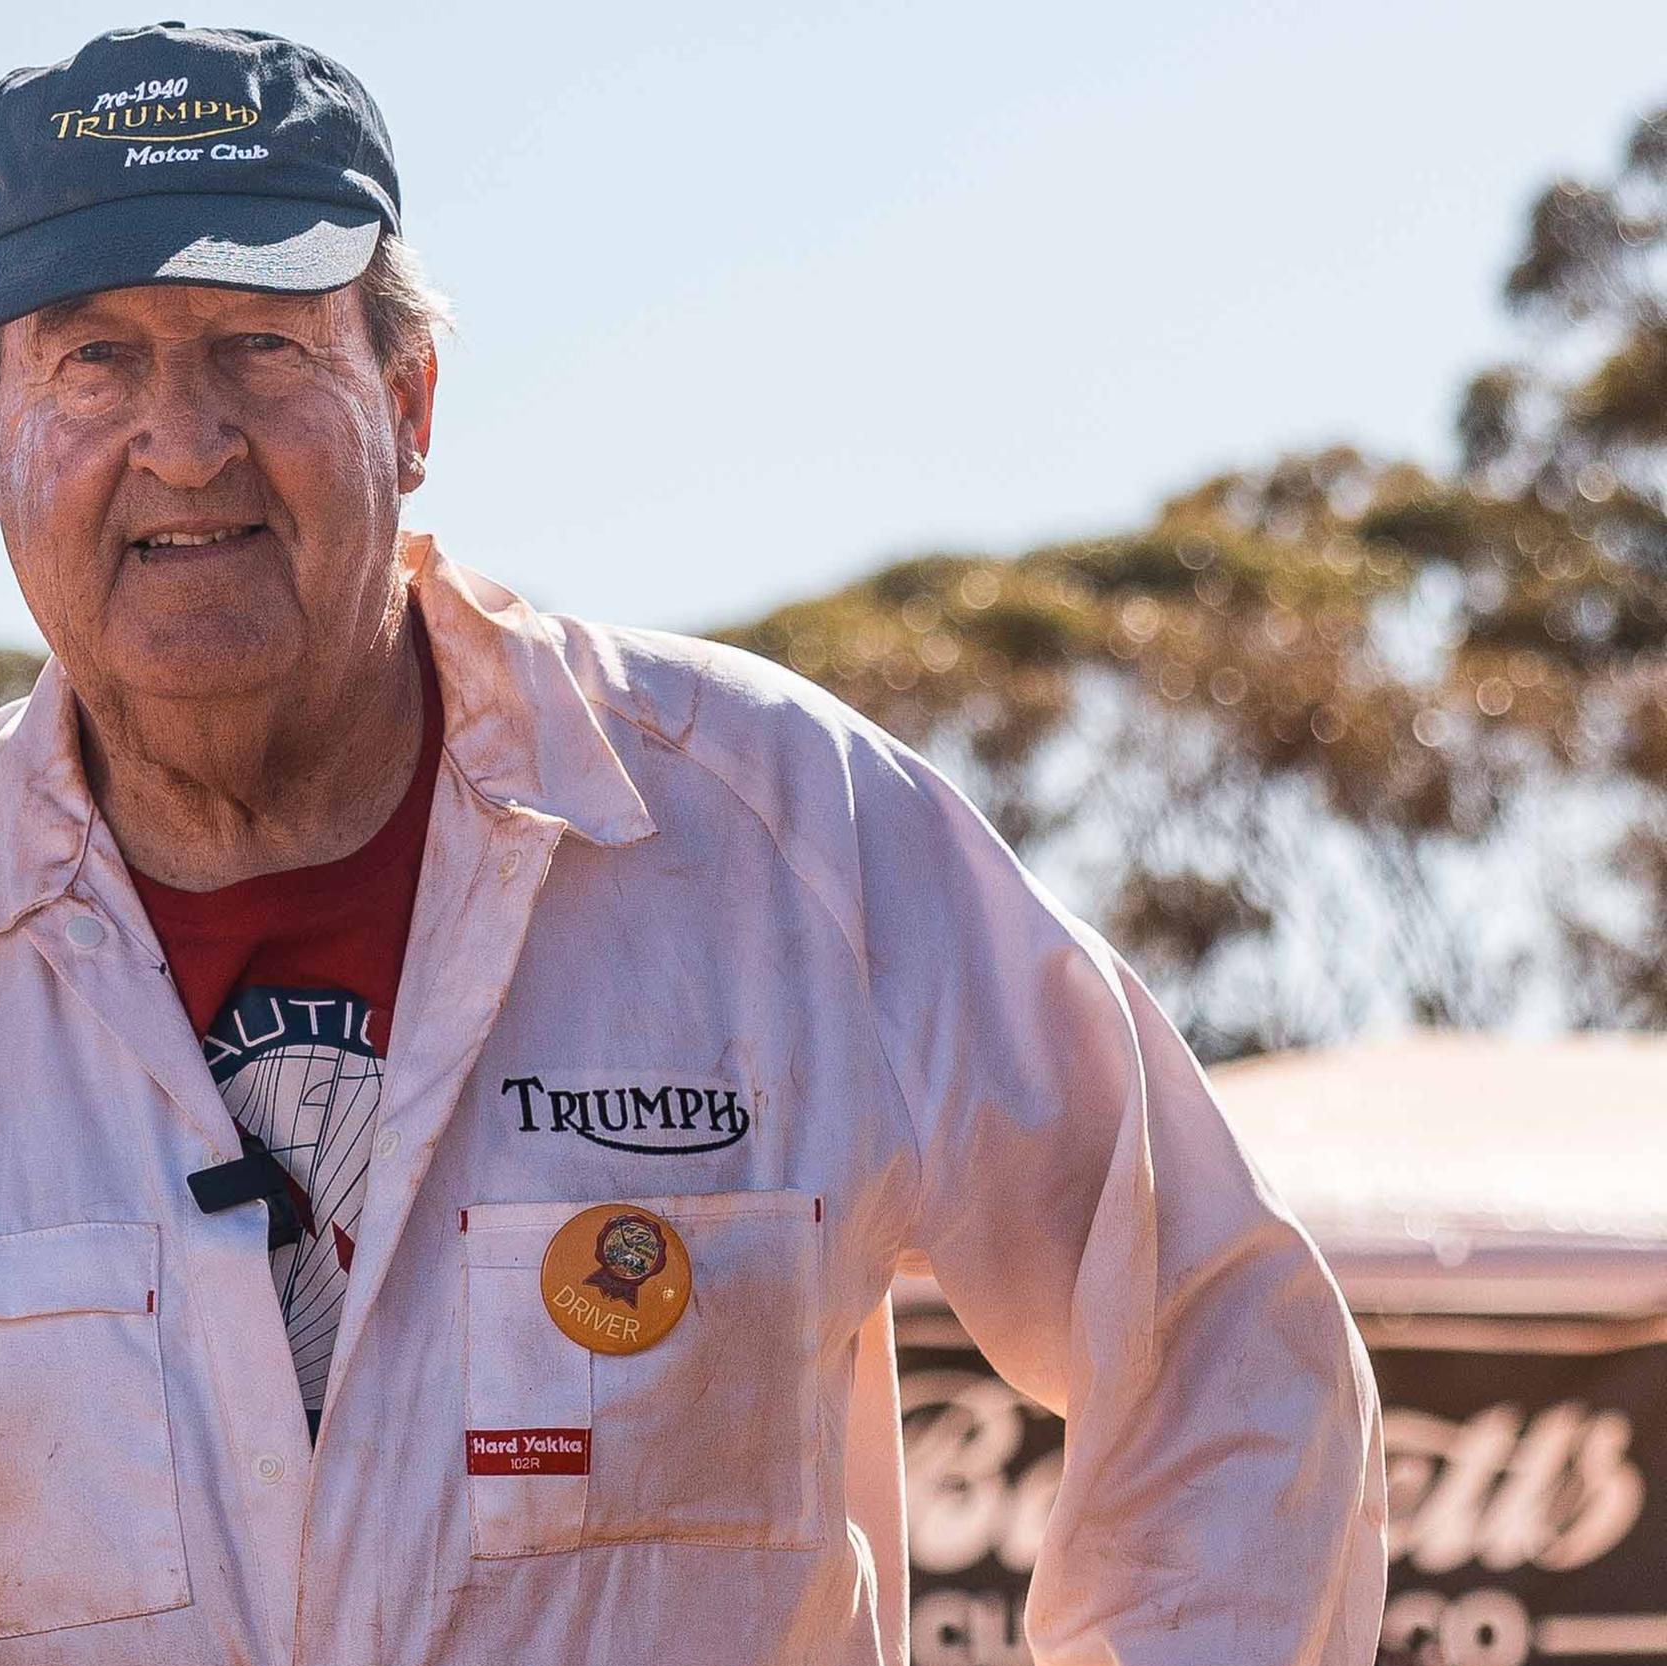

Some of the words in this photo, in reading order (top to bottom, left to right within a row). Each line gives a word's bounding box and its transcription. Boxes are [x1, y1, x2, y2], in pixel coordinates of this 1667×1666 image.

[91, 76, 189, 113] Pre-1940
[50, 100, 258, 141] TRIUMPH
[124, 145, 204, 167] Motor
[210, 144, 269, 161] Club
[501, 1076, 750, 1155] TRIUMPH
[552, 1284, 641, 1343] DRIVER
[473, 1437, 518, 1454] Hard
[523, 1436, 583, 1453] Yakka
[510, 1457, 540, 1469] 102R
